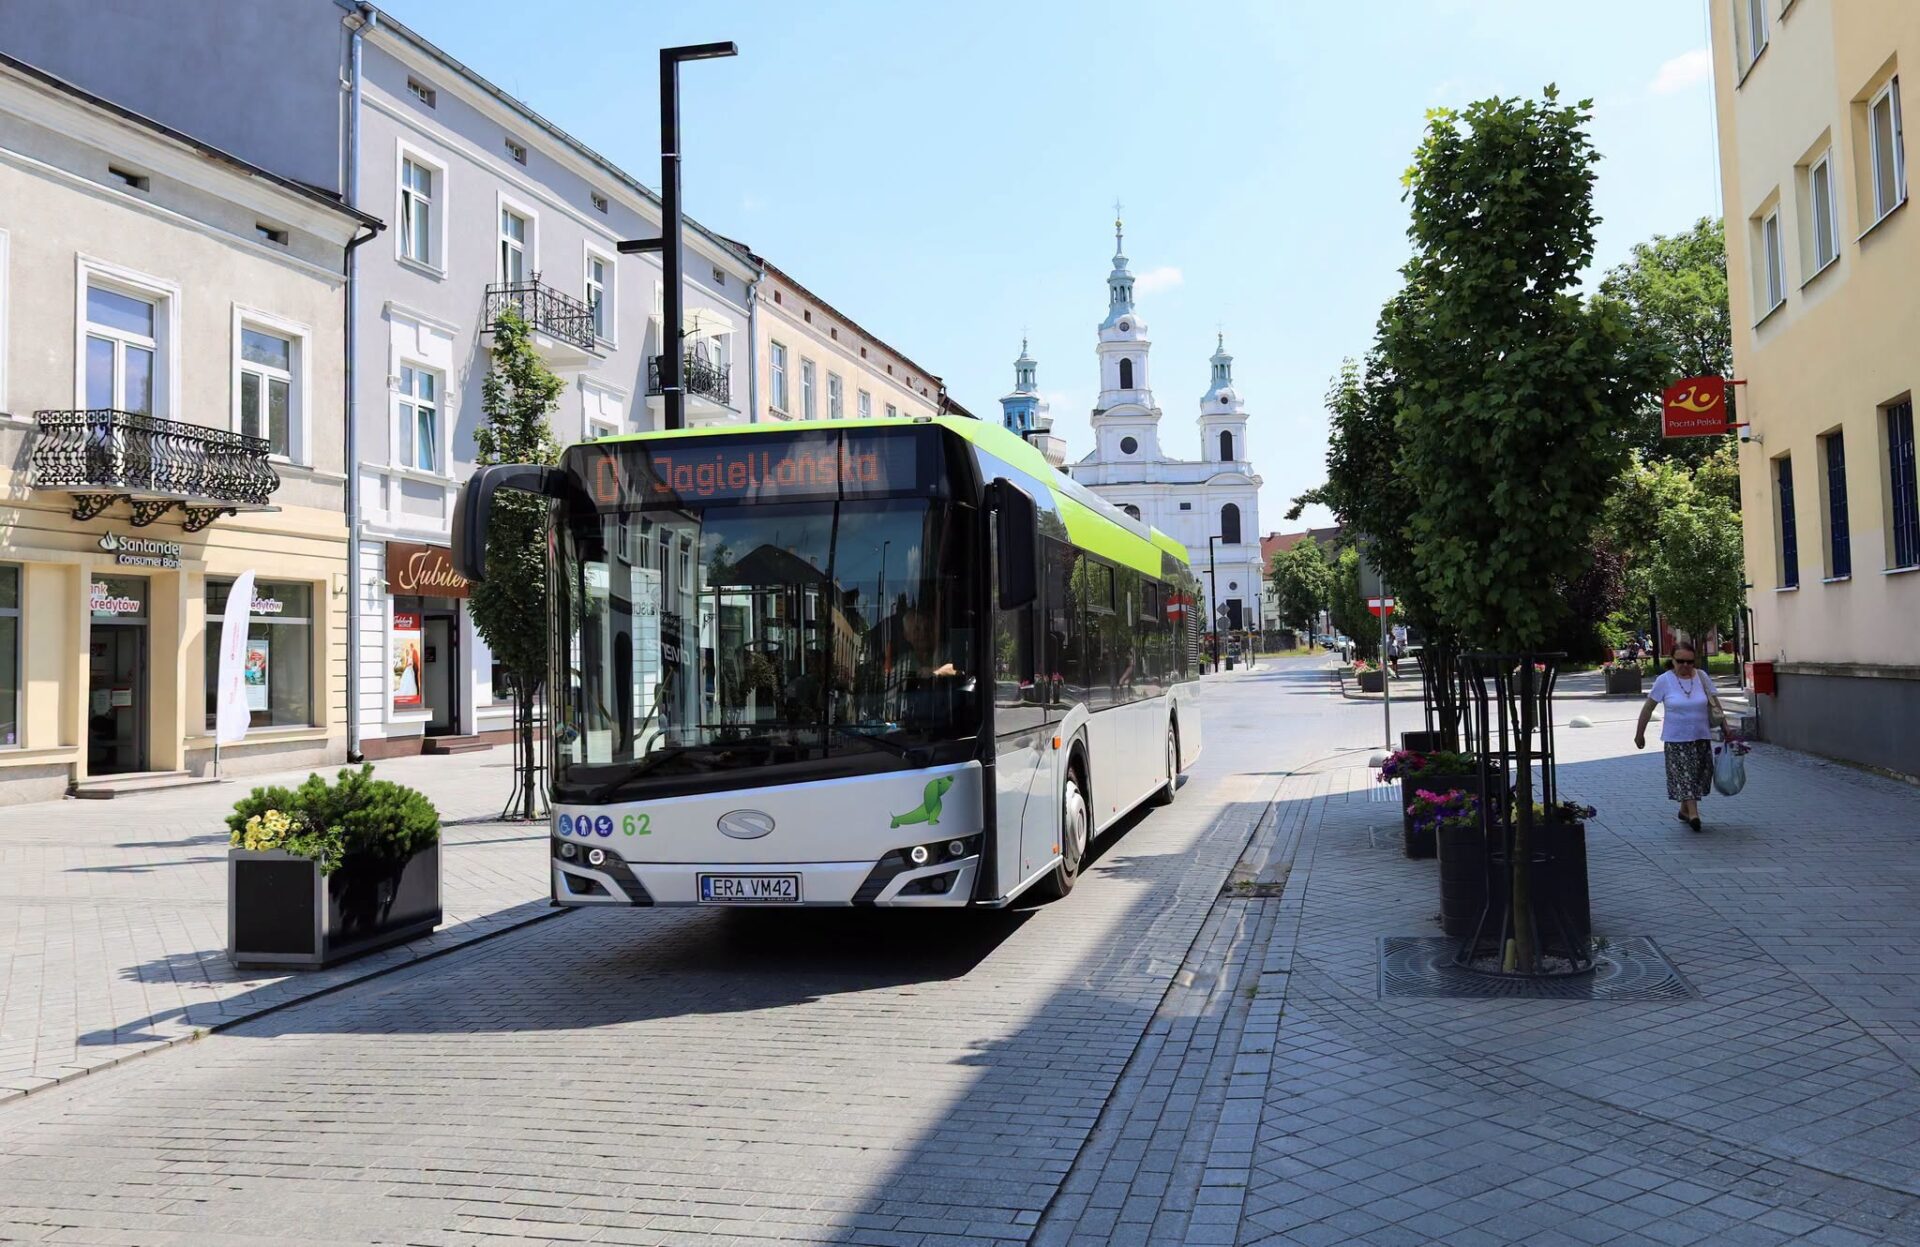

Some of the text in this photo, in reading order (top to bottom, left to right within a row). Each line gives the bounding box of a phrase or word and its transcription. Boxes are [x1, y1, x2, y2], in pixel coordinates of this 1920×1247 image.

[1669, 417, 1722, 428] Poczta Polska
[653, 446, 879, 496] Jagiellońska
[119, 553, 162, 567] Consumer
[622, 813, 652, 836] 62
[713, 879, 792, 896] ERA VM42
